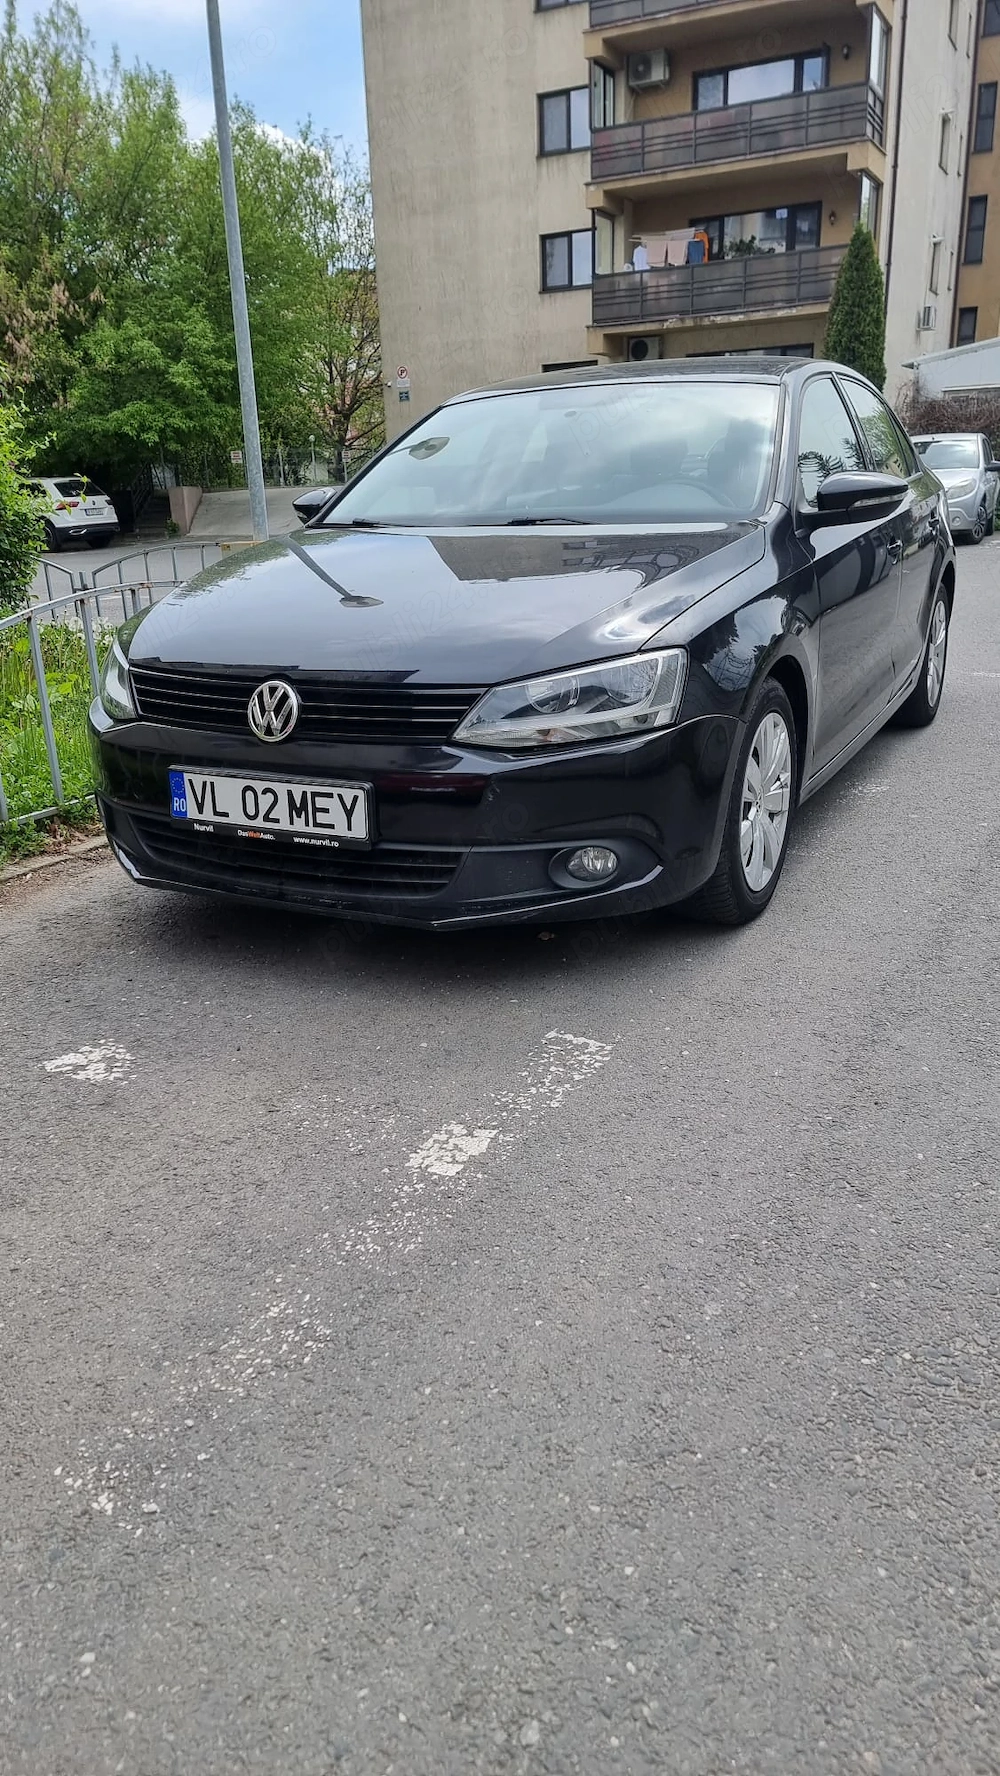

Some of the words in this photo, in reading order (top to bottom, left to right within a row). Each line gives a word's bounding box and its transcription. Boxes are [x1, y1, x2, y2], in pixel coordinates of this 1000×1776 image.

[173, 797, 186, 812] RO
[188, 778, 230, 818] VL
[241, 785, 280, 824] 02
[287, 789, 359, 832] MEY
